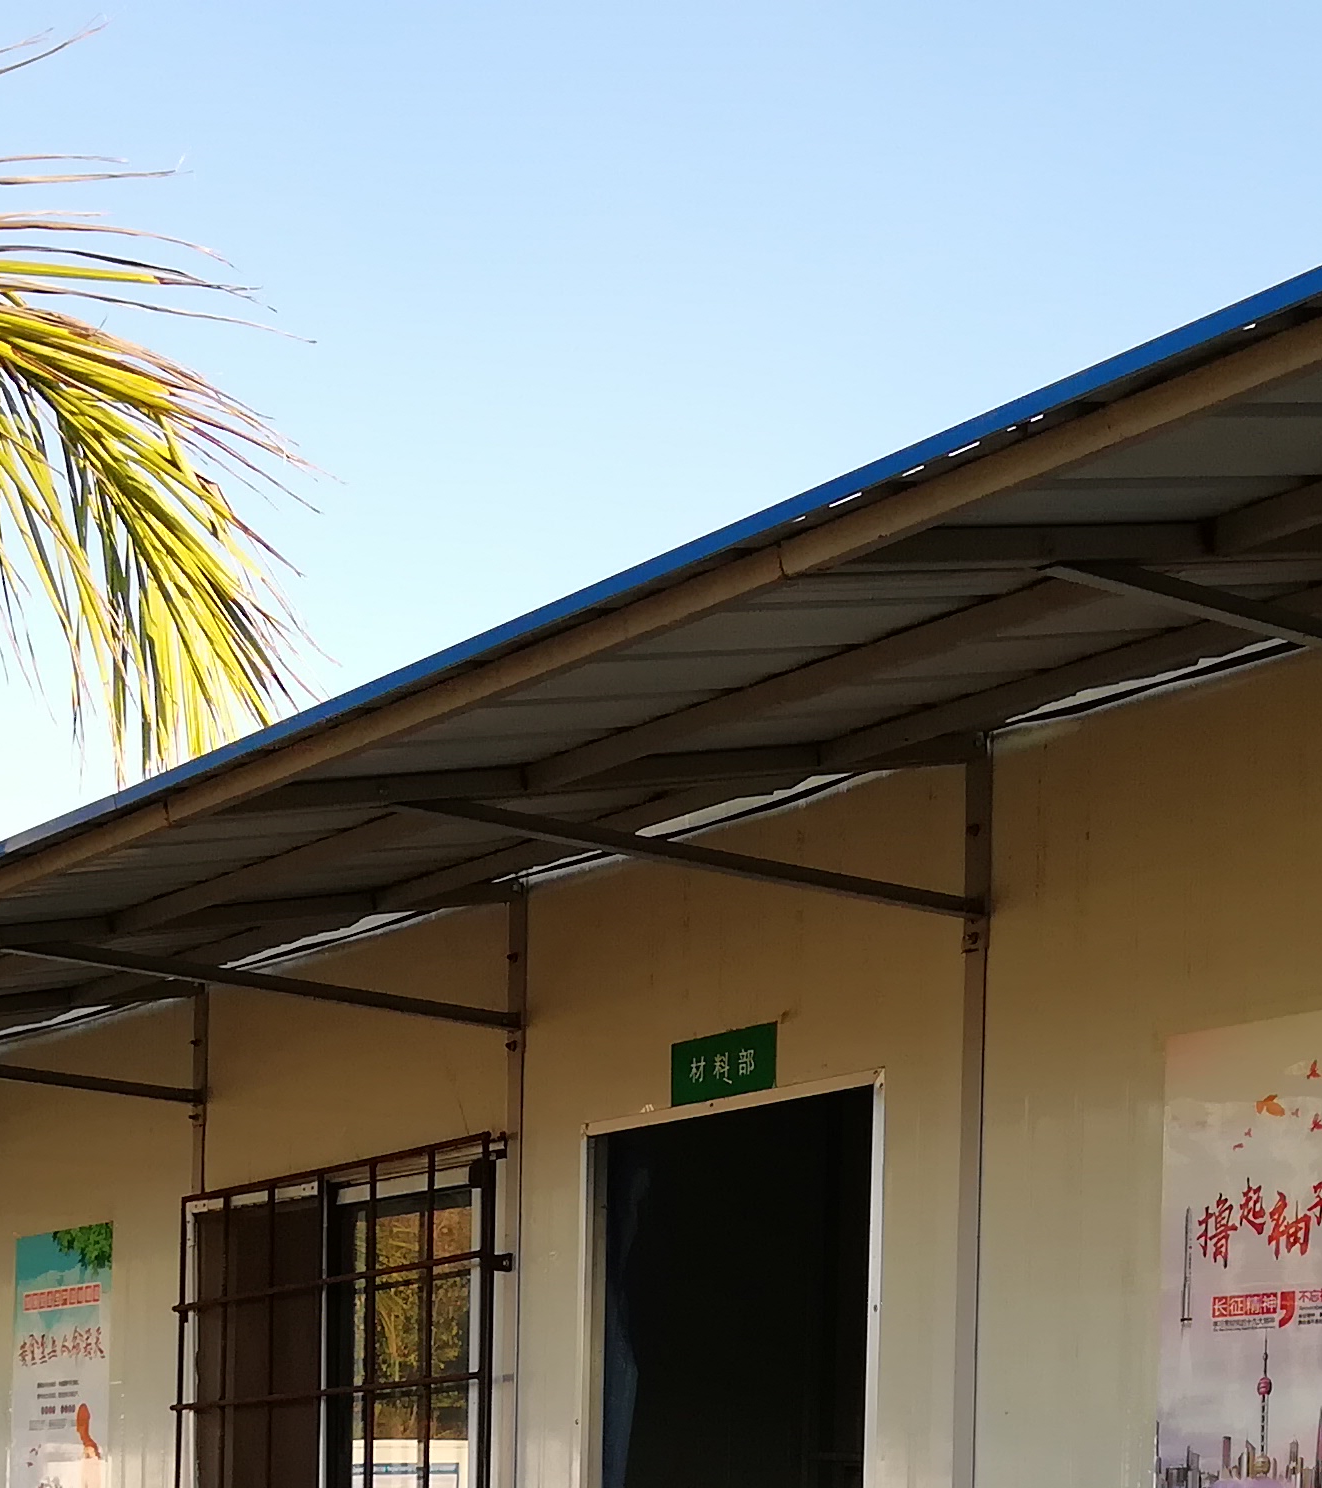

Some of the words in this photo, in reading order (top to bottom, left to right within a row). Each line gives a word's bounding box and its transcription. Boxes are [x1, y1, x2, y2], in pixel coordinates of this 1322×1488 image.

[689, 1049, 755, 1084] 材料部
[1213, 1294, 1277, 1316] 长征精神
